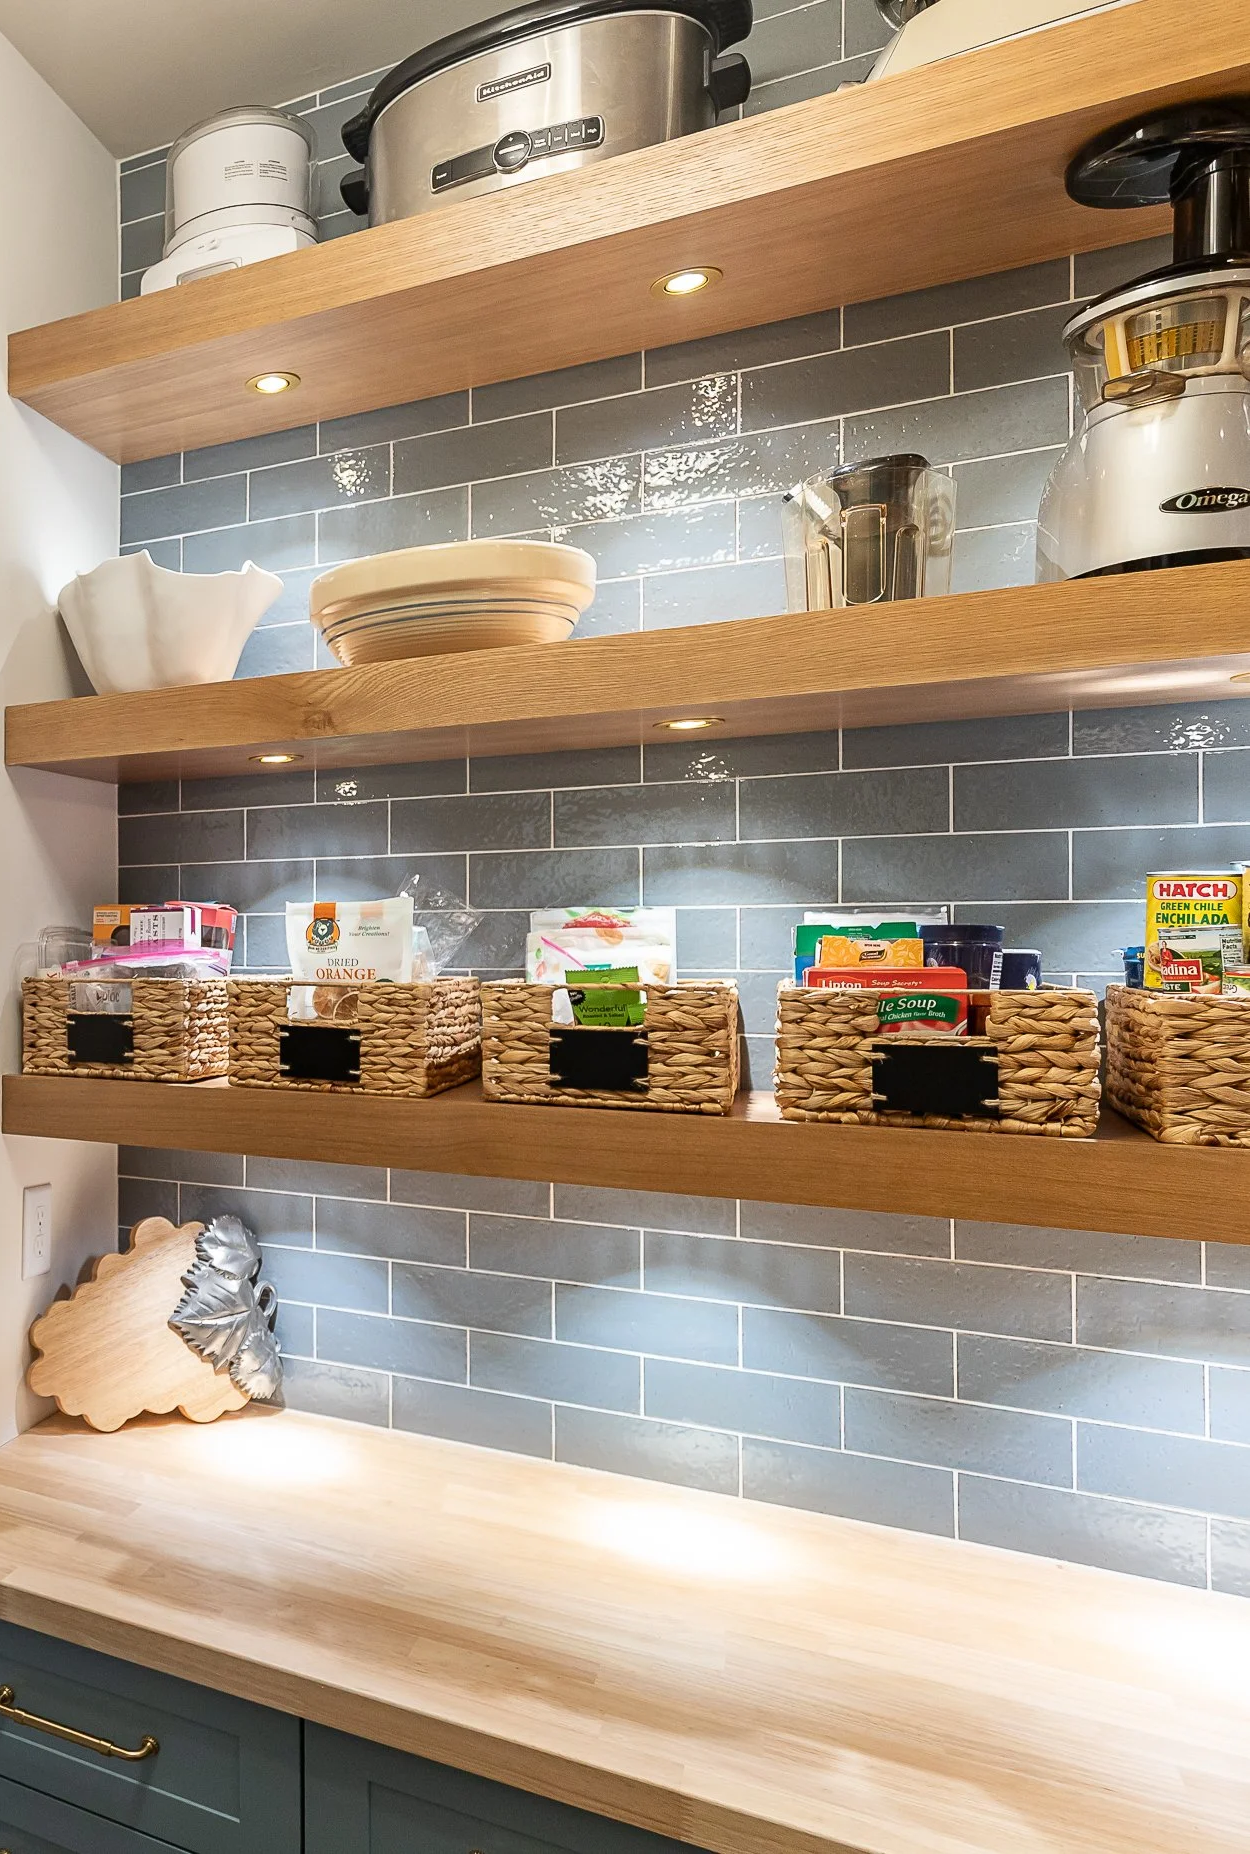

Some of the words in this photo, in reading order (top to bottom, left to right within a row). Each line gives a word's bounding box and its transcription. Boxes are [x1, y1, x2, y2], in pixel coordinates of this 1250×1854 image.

[482, 70, 546, 97] KitchenAid
[1175, 492, 1250, 510] Omega
[1158, 883, 1228, 899] HATCH
[1160, 901, 1192, 912] GREEN
[1194, 901, 1224, 912] CHILE
[1155, 913, 1230, 926] ENCHILADA
[358, 924, 380, 933] Brighten
[362, 931, 391, 940] Creations!
[1221, 943, 1238, 951] Facts
[327, 957, 359, 970] DRIED
[315, 968, 377, 981] ORANGE
[821, 979, 863, 989] Lipton
[871, 980, 891, 991] Soup
[892, 979, 920, 991] Secrets
[579, 1003, 626, 1015] Wonderful
[896, 998, 938, 1014] Soup
[887, 1011, 913, 1025] Chicken
[928, 1010, 946, 1019] Broth
